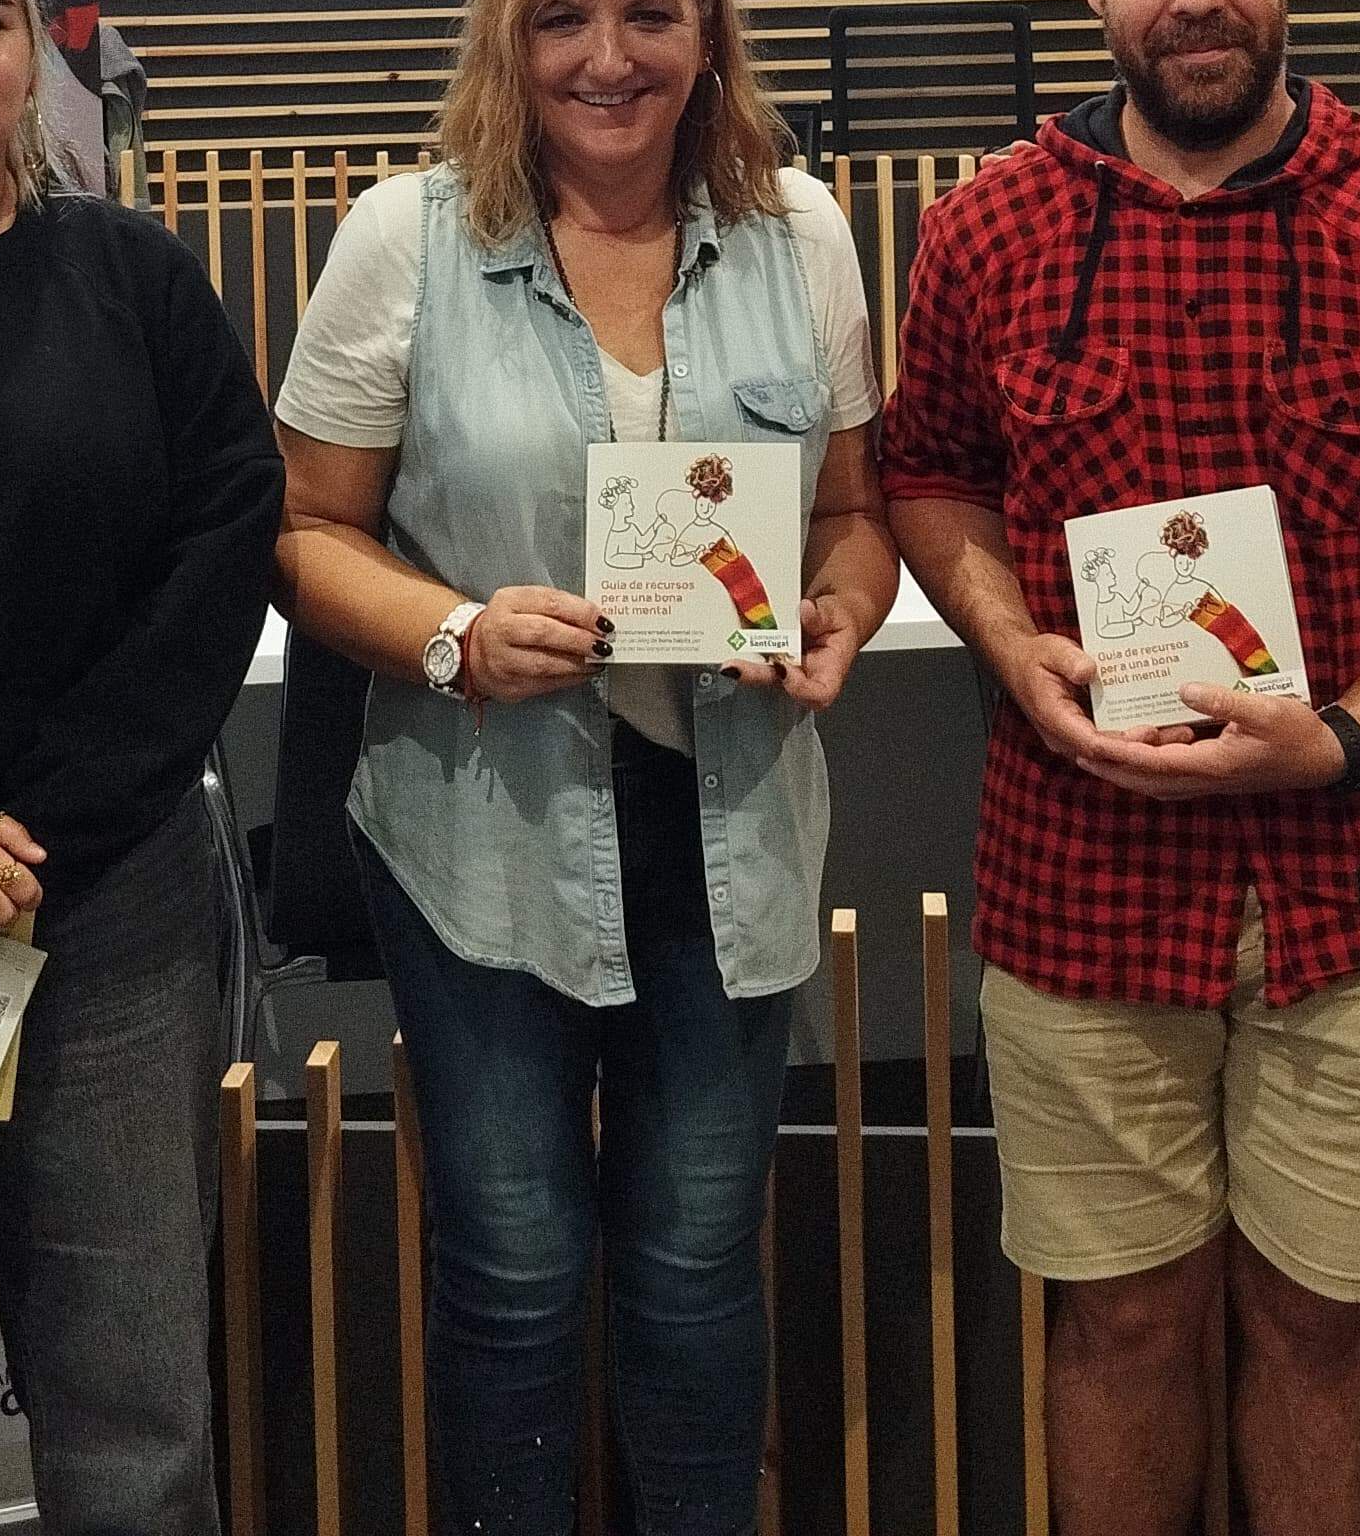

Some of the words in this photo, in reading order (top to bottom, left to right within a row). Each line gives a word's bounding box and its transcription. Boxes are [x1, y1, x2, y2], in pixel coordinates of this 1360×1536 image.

[601, 580, 626, 590] Guia
[629, 580, 643, 590] de
[645, 581, 695, 591] recursos
[601, 594, 619, 605] per
[631, 595, 652, 603] una
[654, 593, 683, 603] bona
[632, 606, 671, 615] mental
[1124, 647, 1138, 658] de
[1140, 640, 1190, 655] recursos
[1100, 664, 1117, 677] per
[1128, 659, 1150, 670] una
[1151, 655, 1180, 666] bona
[1102, 674, 1129, 686] salut
[1132, 667, 1171, 682] mental
